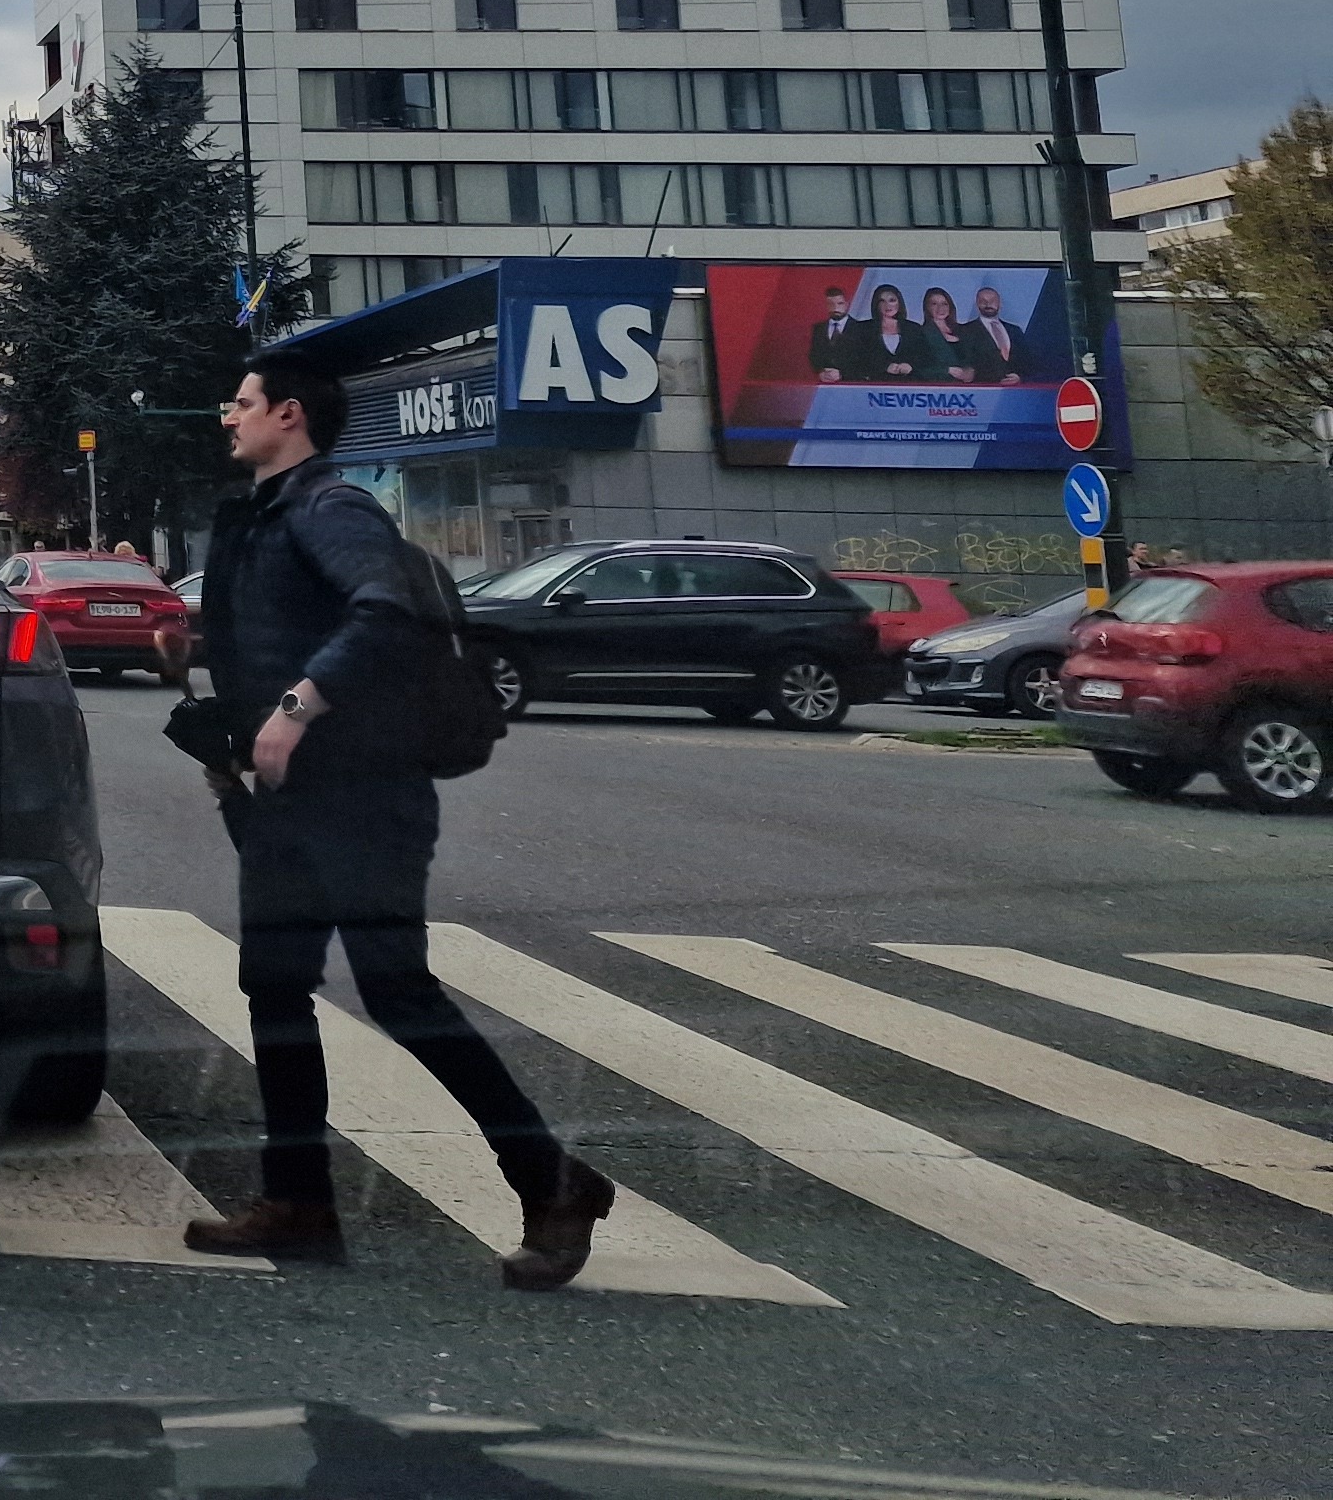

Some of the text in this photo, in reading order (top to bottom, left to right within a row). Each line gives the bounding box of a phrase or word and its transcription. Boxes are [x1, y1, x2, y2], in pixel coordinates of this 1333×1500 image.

[519, 304, 659, 404] AS
[397, 376, 456, 436] HOŠE
[868, 392, 977, 409] NEWSMAX
[928, 408, 978, 417] BALKANS
[856, 431, 887, 439] PRAVE
[888, 431, 921, 441] VIJESTI
[923, 432, 936, 440] ZA
[938, 432, 968, 440] PRAVE
